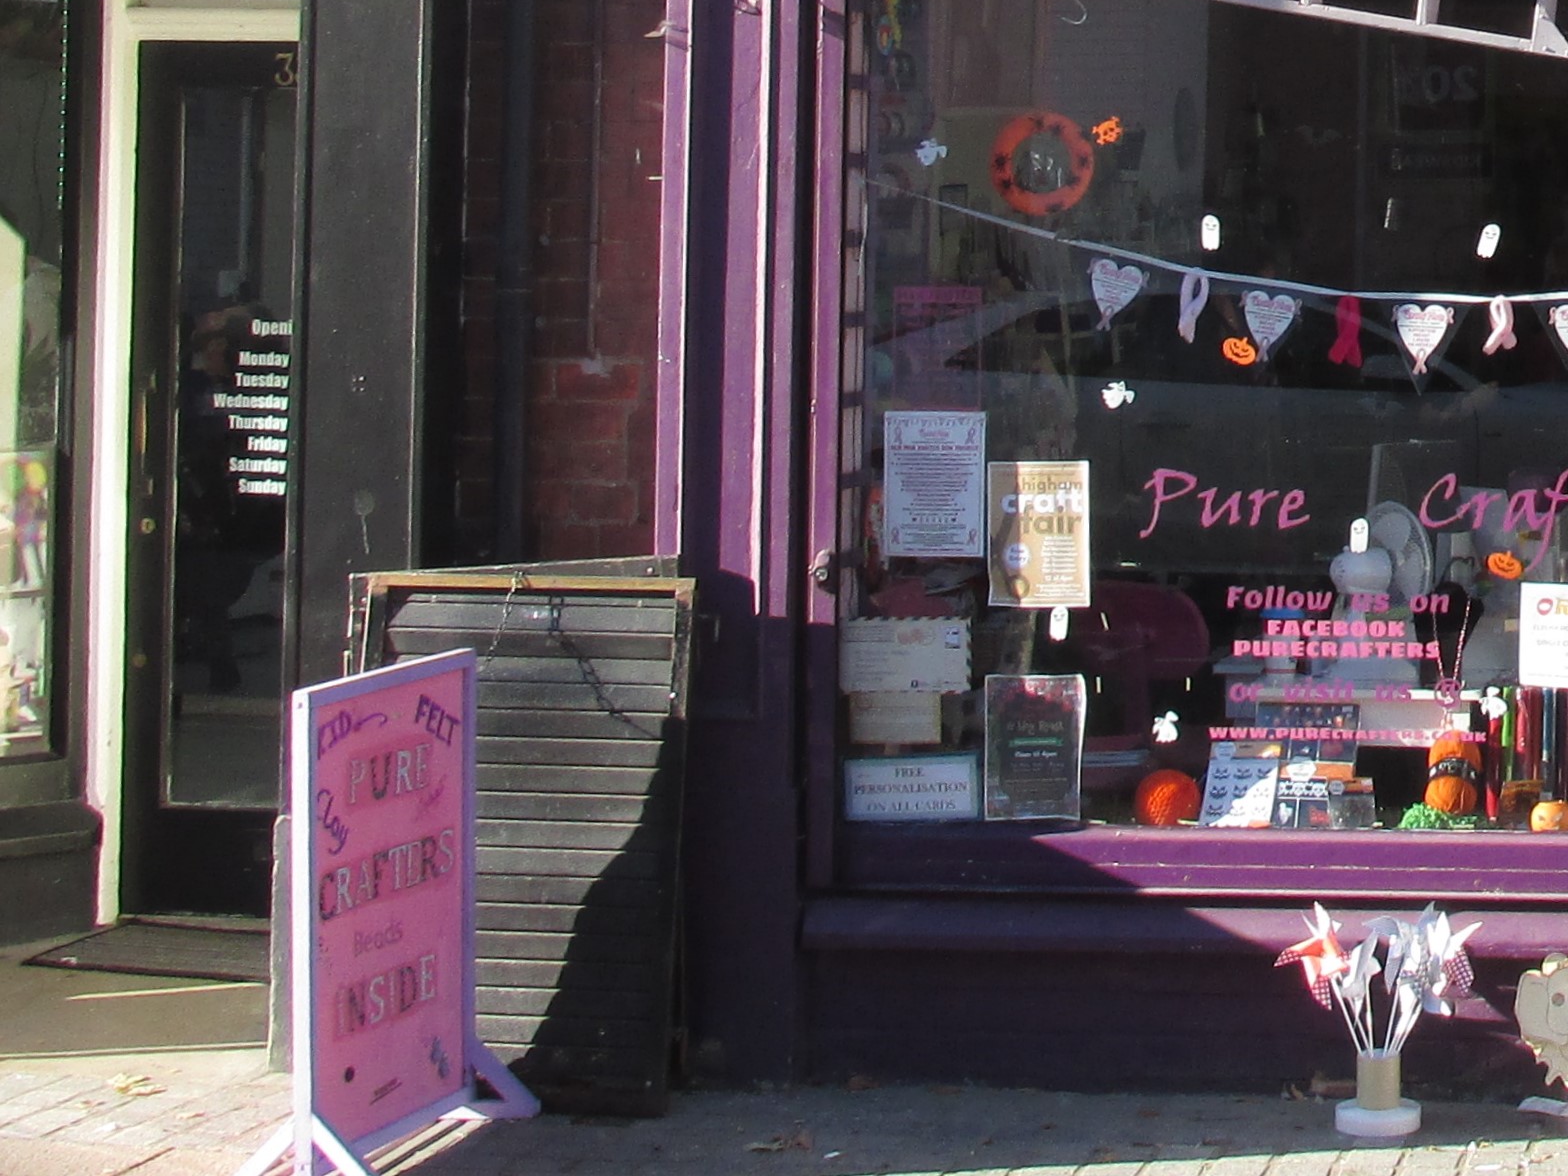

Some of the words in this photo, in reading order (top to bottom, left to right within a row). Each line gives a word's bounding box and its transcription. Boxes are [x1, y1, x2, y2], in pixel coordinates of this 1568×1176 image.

[274, 52, 301, 86] 3
[239, 351, 291, 368] Monday
[235, 372, 290, 390] Tuesday
[213, 393, 290, 412] Wednesday
[228, 414, 289, 432] Thursday
[247, 435, 288, 454] Friday
[229, 456, 288, 476] Saturday
[238, 477, 287, 497] Sunday
[1022, 476, 1083, 494] higham
[1001, 488, 1084, 515] craft
[1140, 467, 1310, 538] Pure
[1019, 501, 1083, 535] fair
[1226, 585, 1333, 611] Follow
[1351, 593, 1391, 613] us
[1409, 593, 1450, 614] on
[1267, 620, 1406, 638] FACEBOOK
[1233, 640, 1441, 659] PURECRAFTERS
[1284, 676, 1354, 702] visit
[1375, 681, 1412, 703] us
[414, 694, 461, 747] FELT
[348, 743, 433, 805] PURE
[894, 766, 926, 779] FREE
[853, 780, 968, 795] PERSONALISATION
[914, 798, 957, 812] CARDS
[319, 826, 456, 921] CRAFTERS
[335, 953, 437, 1038] INSIDE
